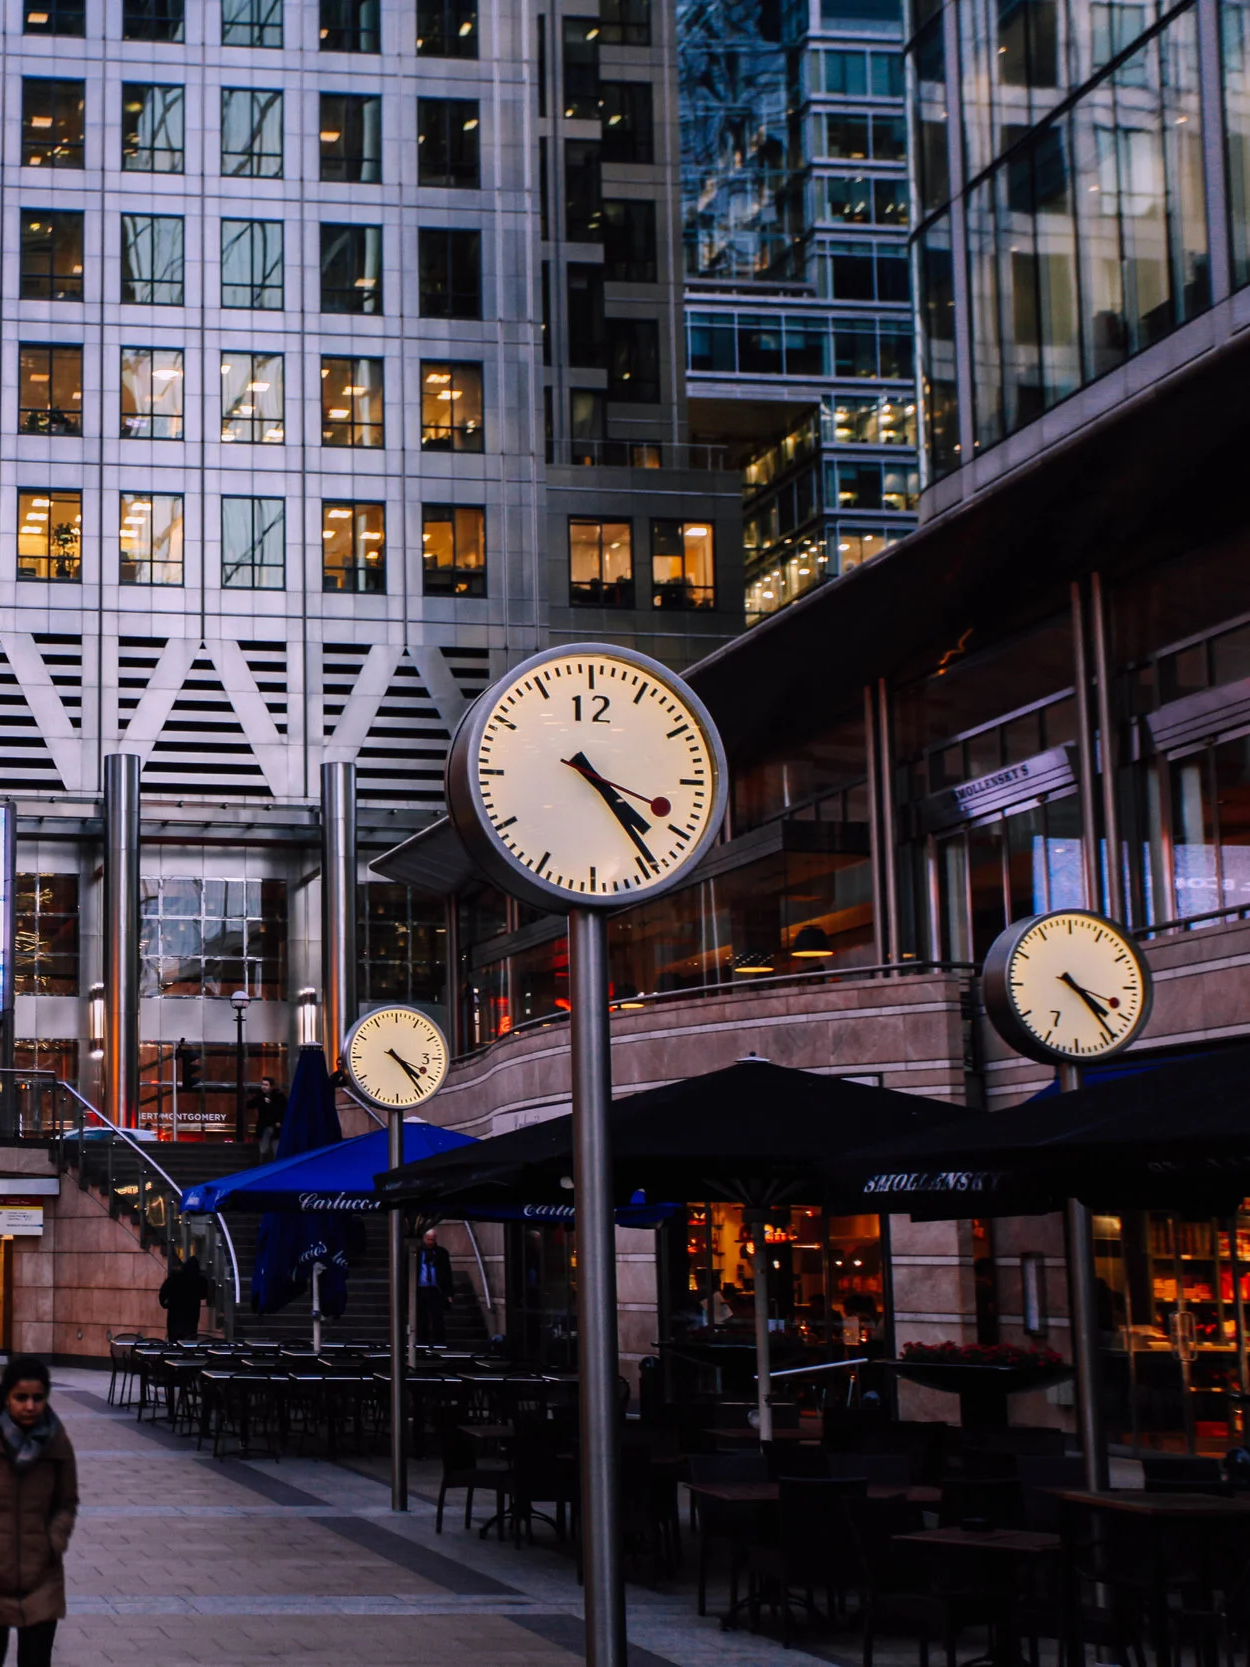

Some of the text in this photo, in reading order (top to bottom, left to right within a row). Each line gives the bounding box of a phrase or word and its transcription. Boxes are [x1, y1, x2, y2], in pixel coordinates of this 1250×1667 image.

[571, 695, 611, 724] 12
[1049, 1010, 1062, 1027] 7
[421, 1052, 430, 1065] 3
